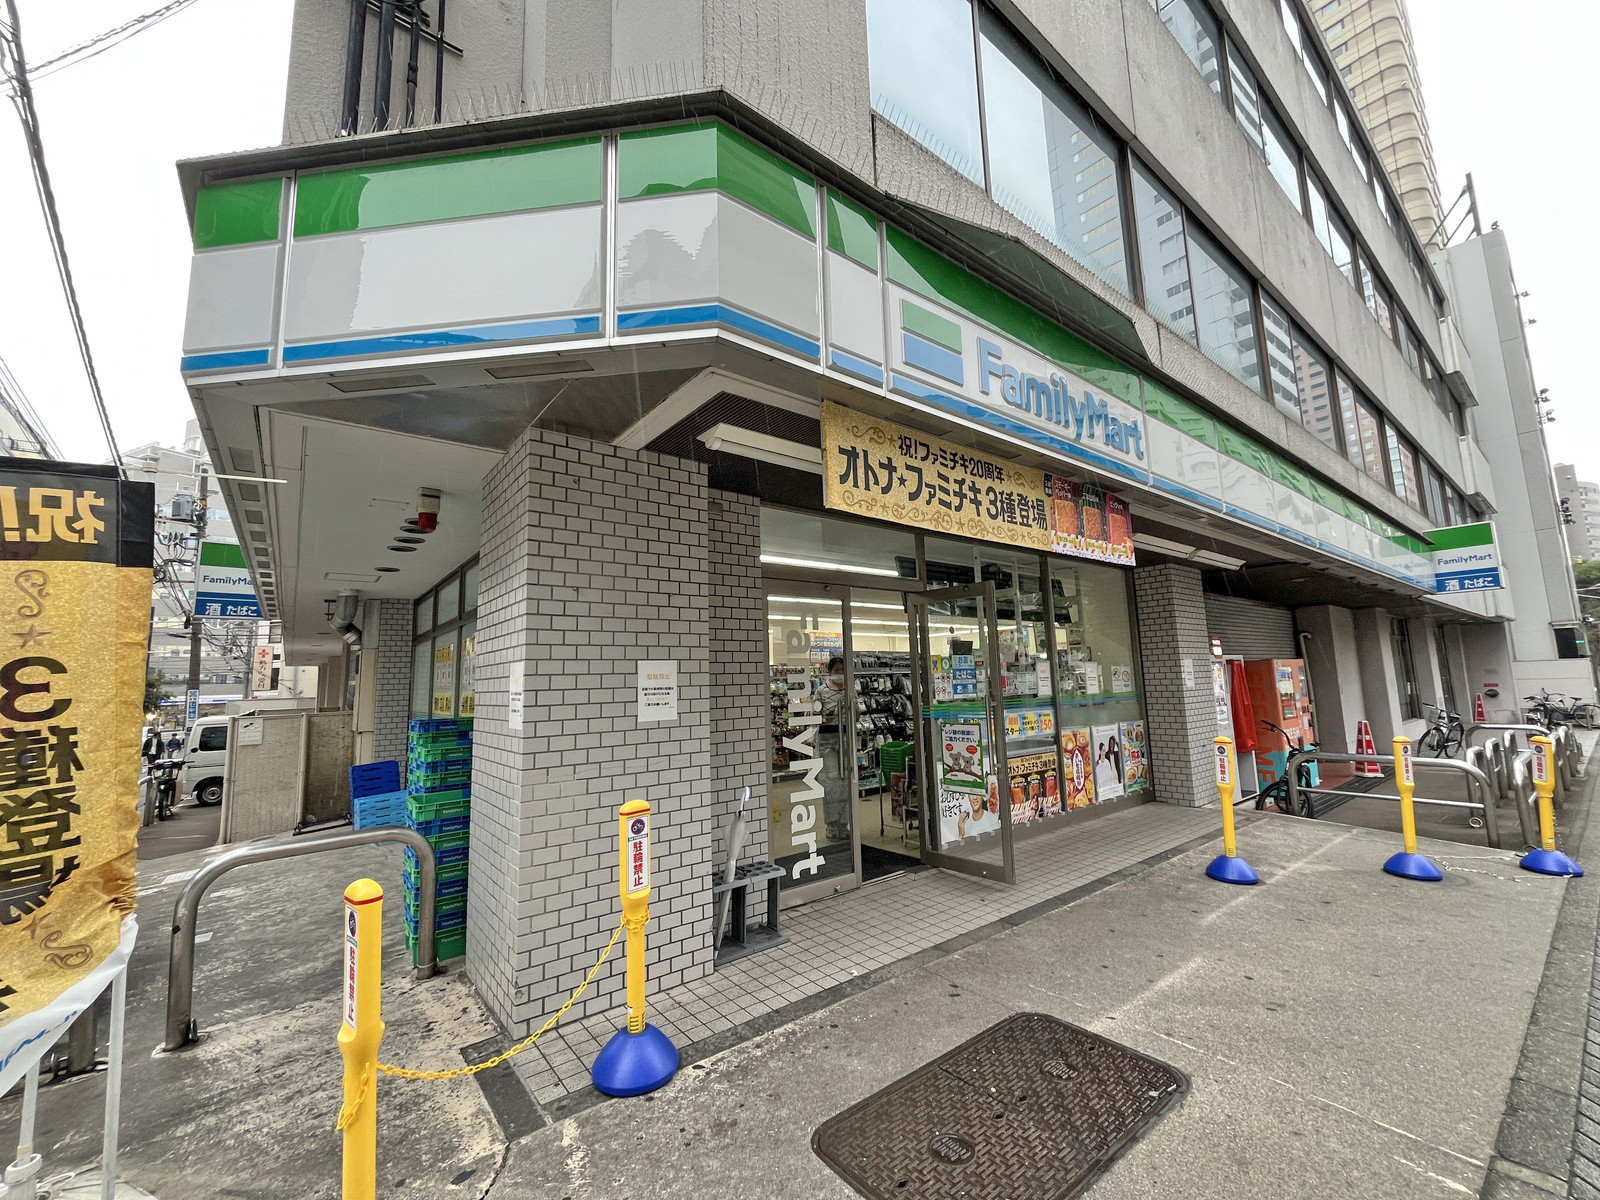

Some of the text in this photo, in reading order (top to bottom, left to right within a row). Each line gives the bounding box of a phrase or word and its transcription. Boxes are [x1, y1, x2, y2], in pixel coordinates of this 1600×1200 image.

[976, 336, 1144, 461] FamilyMart
[898, 434, 1005, 484] 祝!ファミチキ20周年
[1437, 553, 1493, 566] FamilyMart
[1445, 577, 1495, 591] 酒 たばこ
[205, 603, 257, 616] 酒 たばこ
[632, 840, 643, 888] 駐輪禁止
